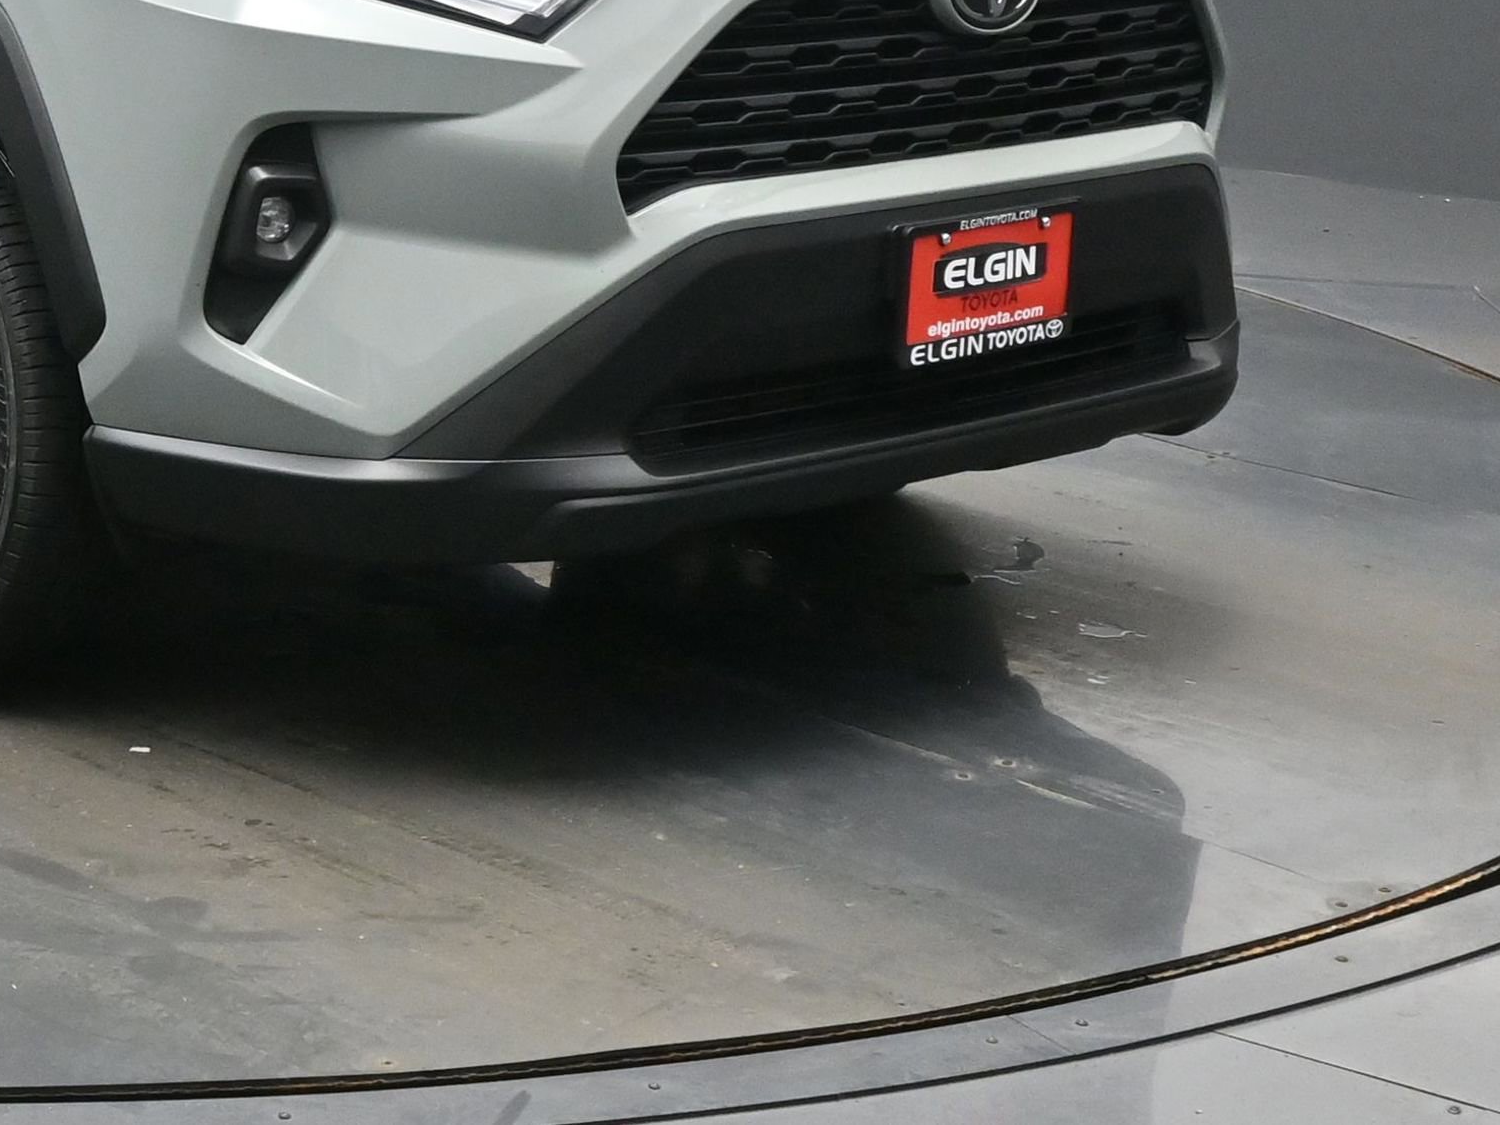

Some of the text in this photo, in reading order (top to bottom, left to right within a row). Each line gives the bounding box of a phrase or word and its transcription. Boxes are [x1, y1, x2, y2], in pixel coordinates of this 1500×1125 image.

[959, 208, 1038, 231] ELGINTOYOTA.COM
[943, 245, 1036, 290] ELGIN
[960, 289, 1019, 312] TOYOTA
[927, 305, 1044, 338] elgintoyota.com
[910, 324, 1046, 367] ELGIN TOYOTA
